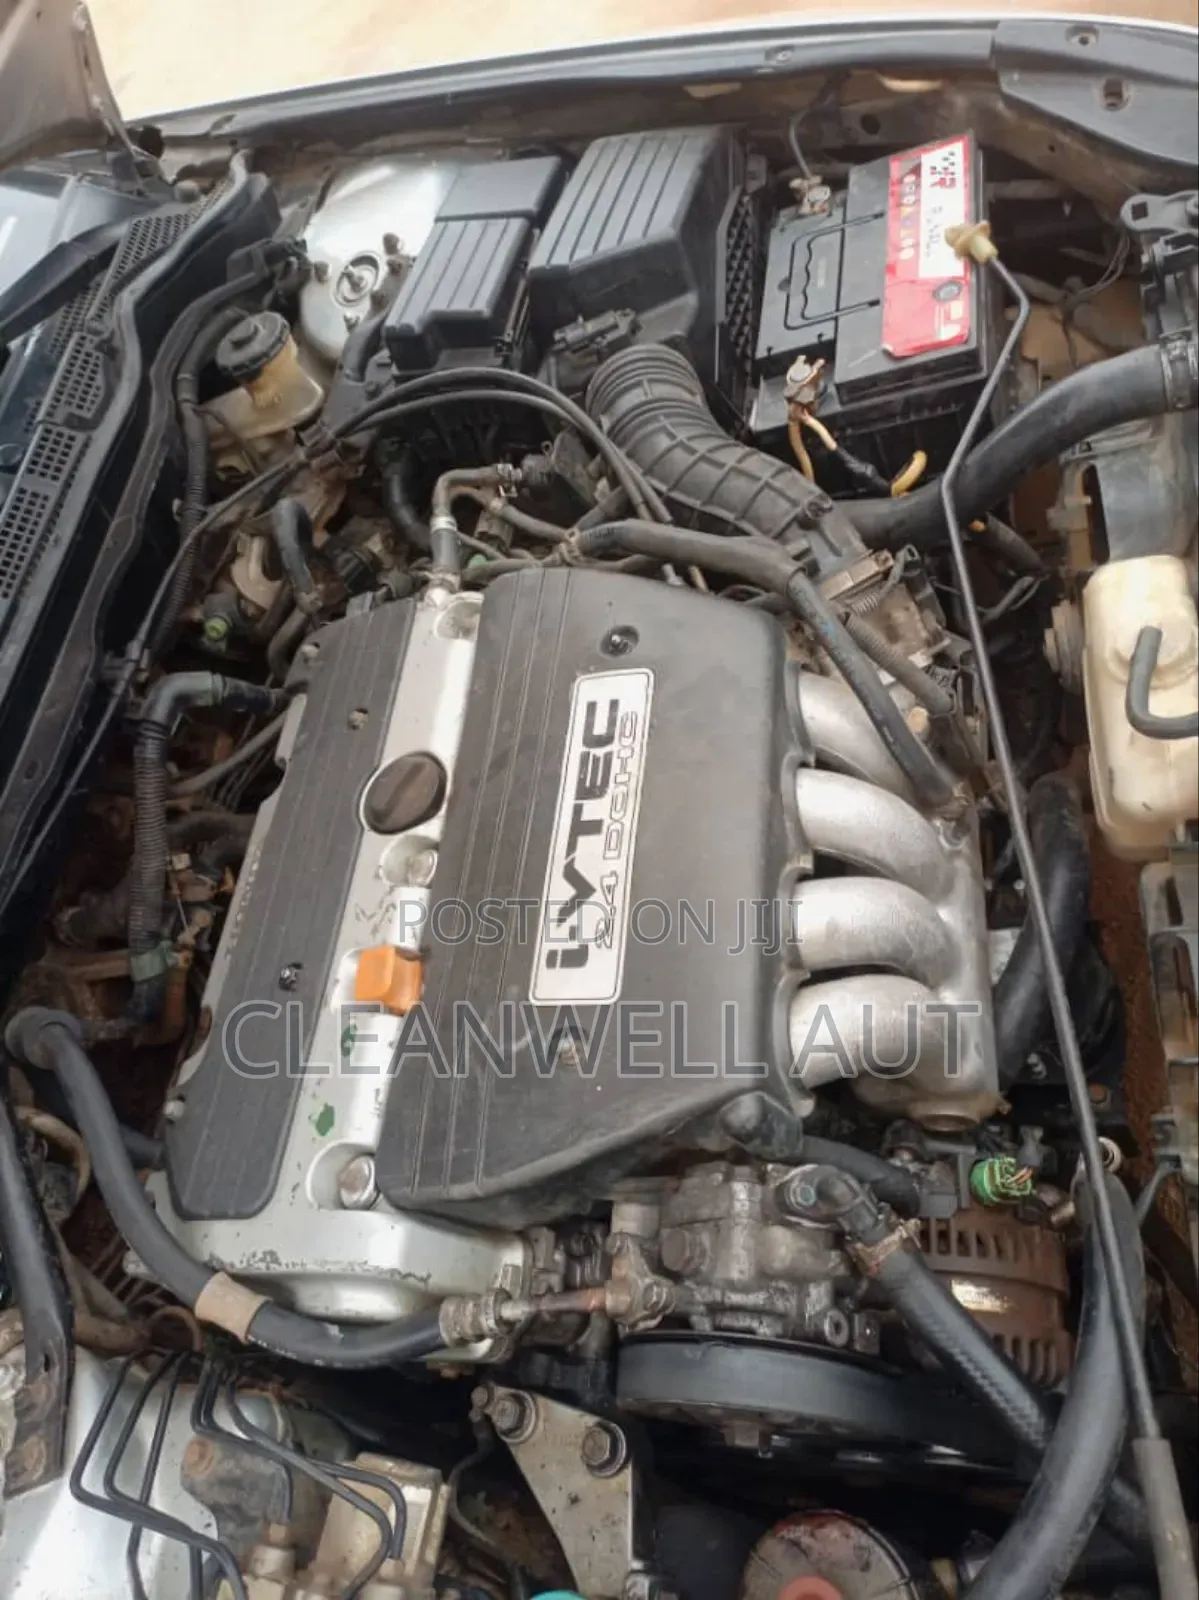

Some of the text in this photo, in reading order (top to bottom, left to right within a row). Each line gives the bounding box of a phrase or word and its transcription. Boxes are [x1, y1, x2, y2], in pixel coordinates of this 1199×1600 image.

[546, 699, 620, 970] i-VTEC
[595, 711, 637, 949] 2.4 DOHC
